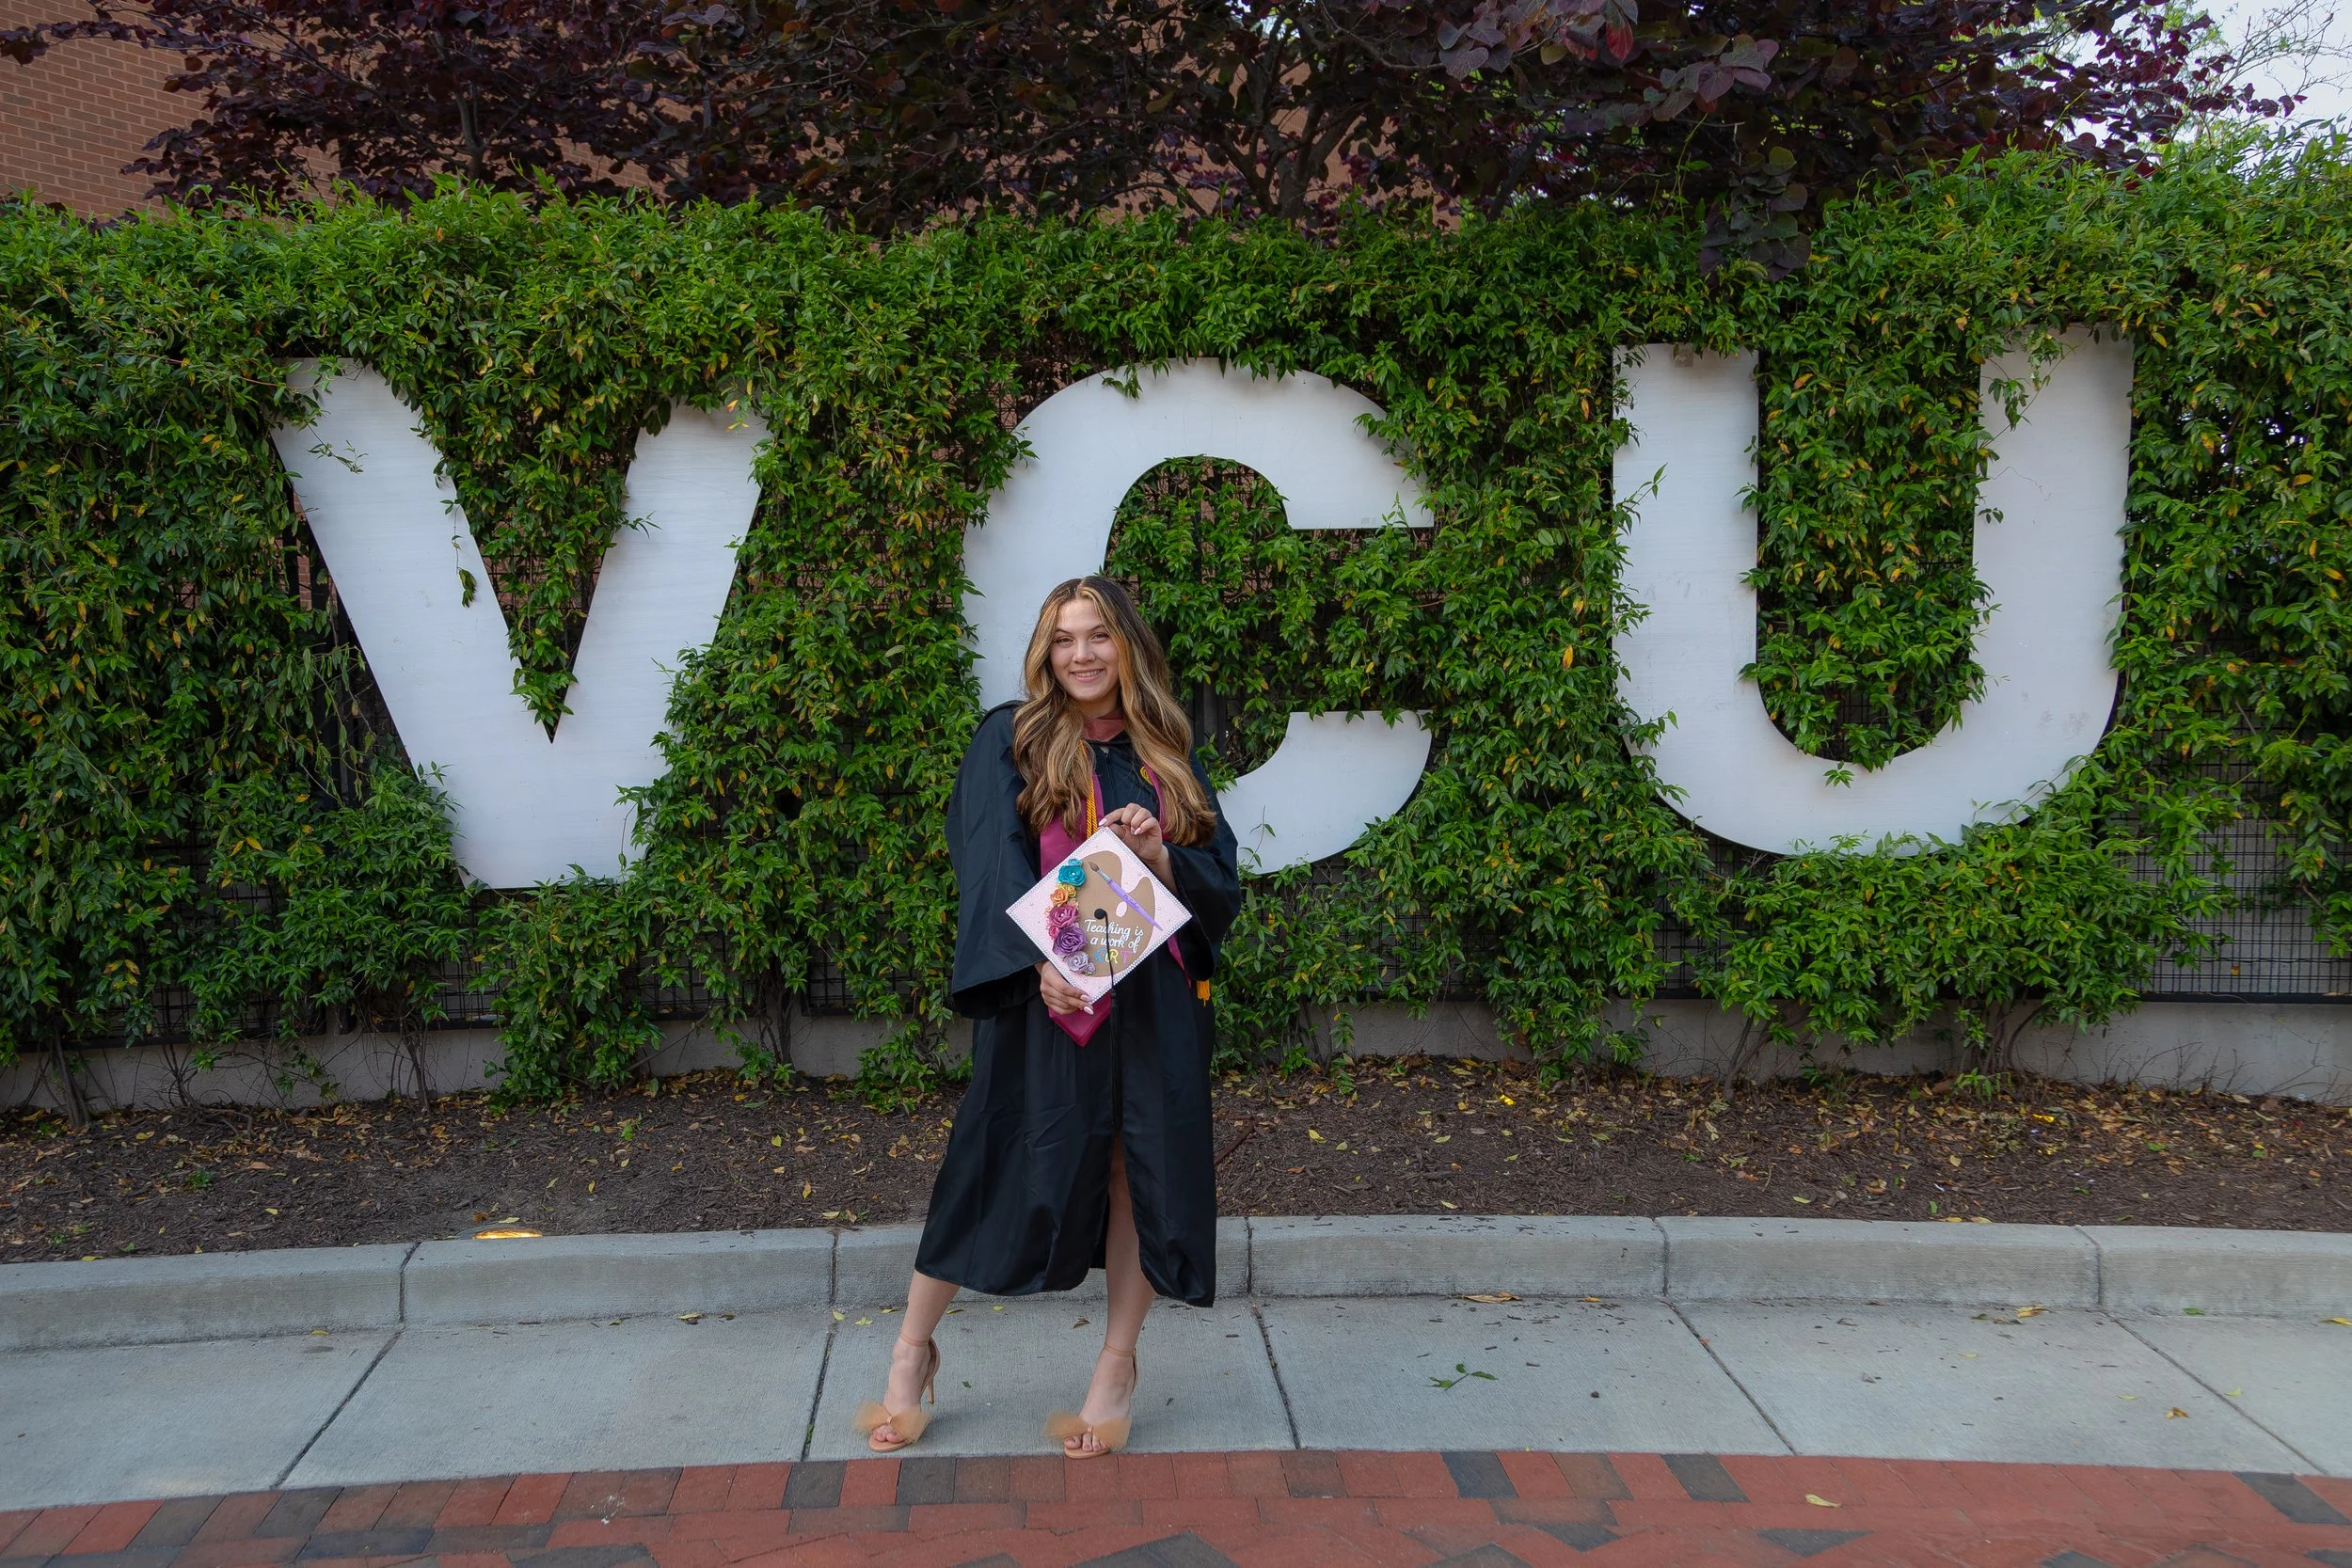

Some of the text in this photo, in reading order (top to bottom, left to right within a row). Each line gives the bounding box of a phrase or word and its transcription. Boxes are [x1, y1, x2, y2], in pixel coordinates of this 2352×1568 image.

[269, 323, 2136, 890] VCU
[1084, 919, 1144, 941] Teaching is
[1090, 935, 1140, 954] a work of
